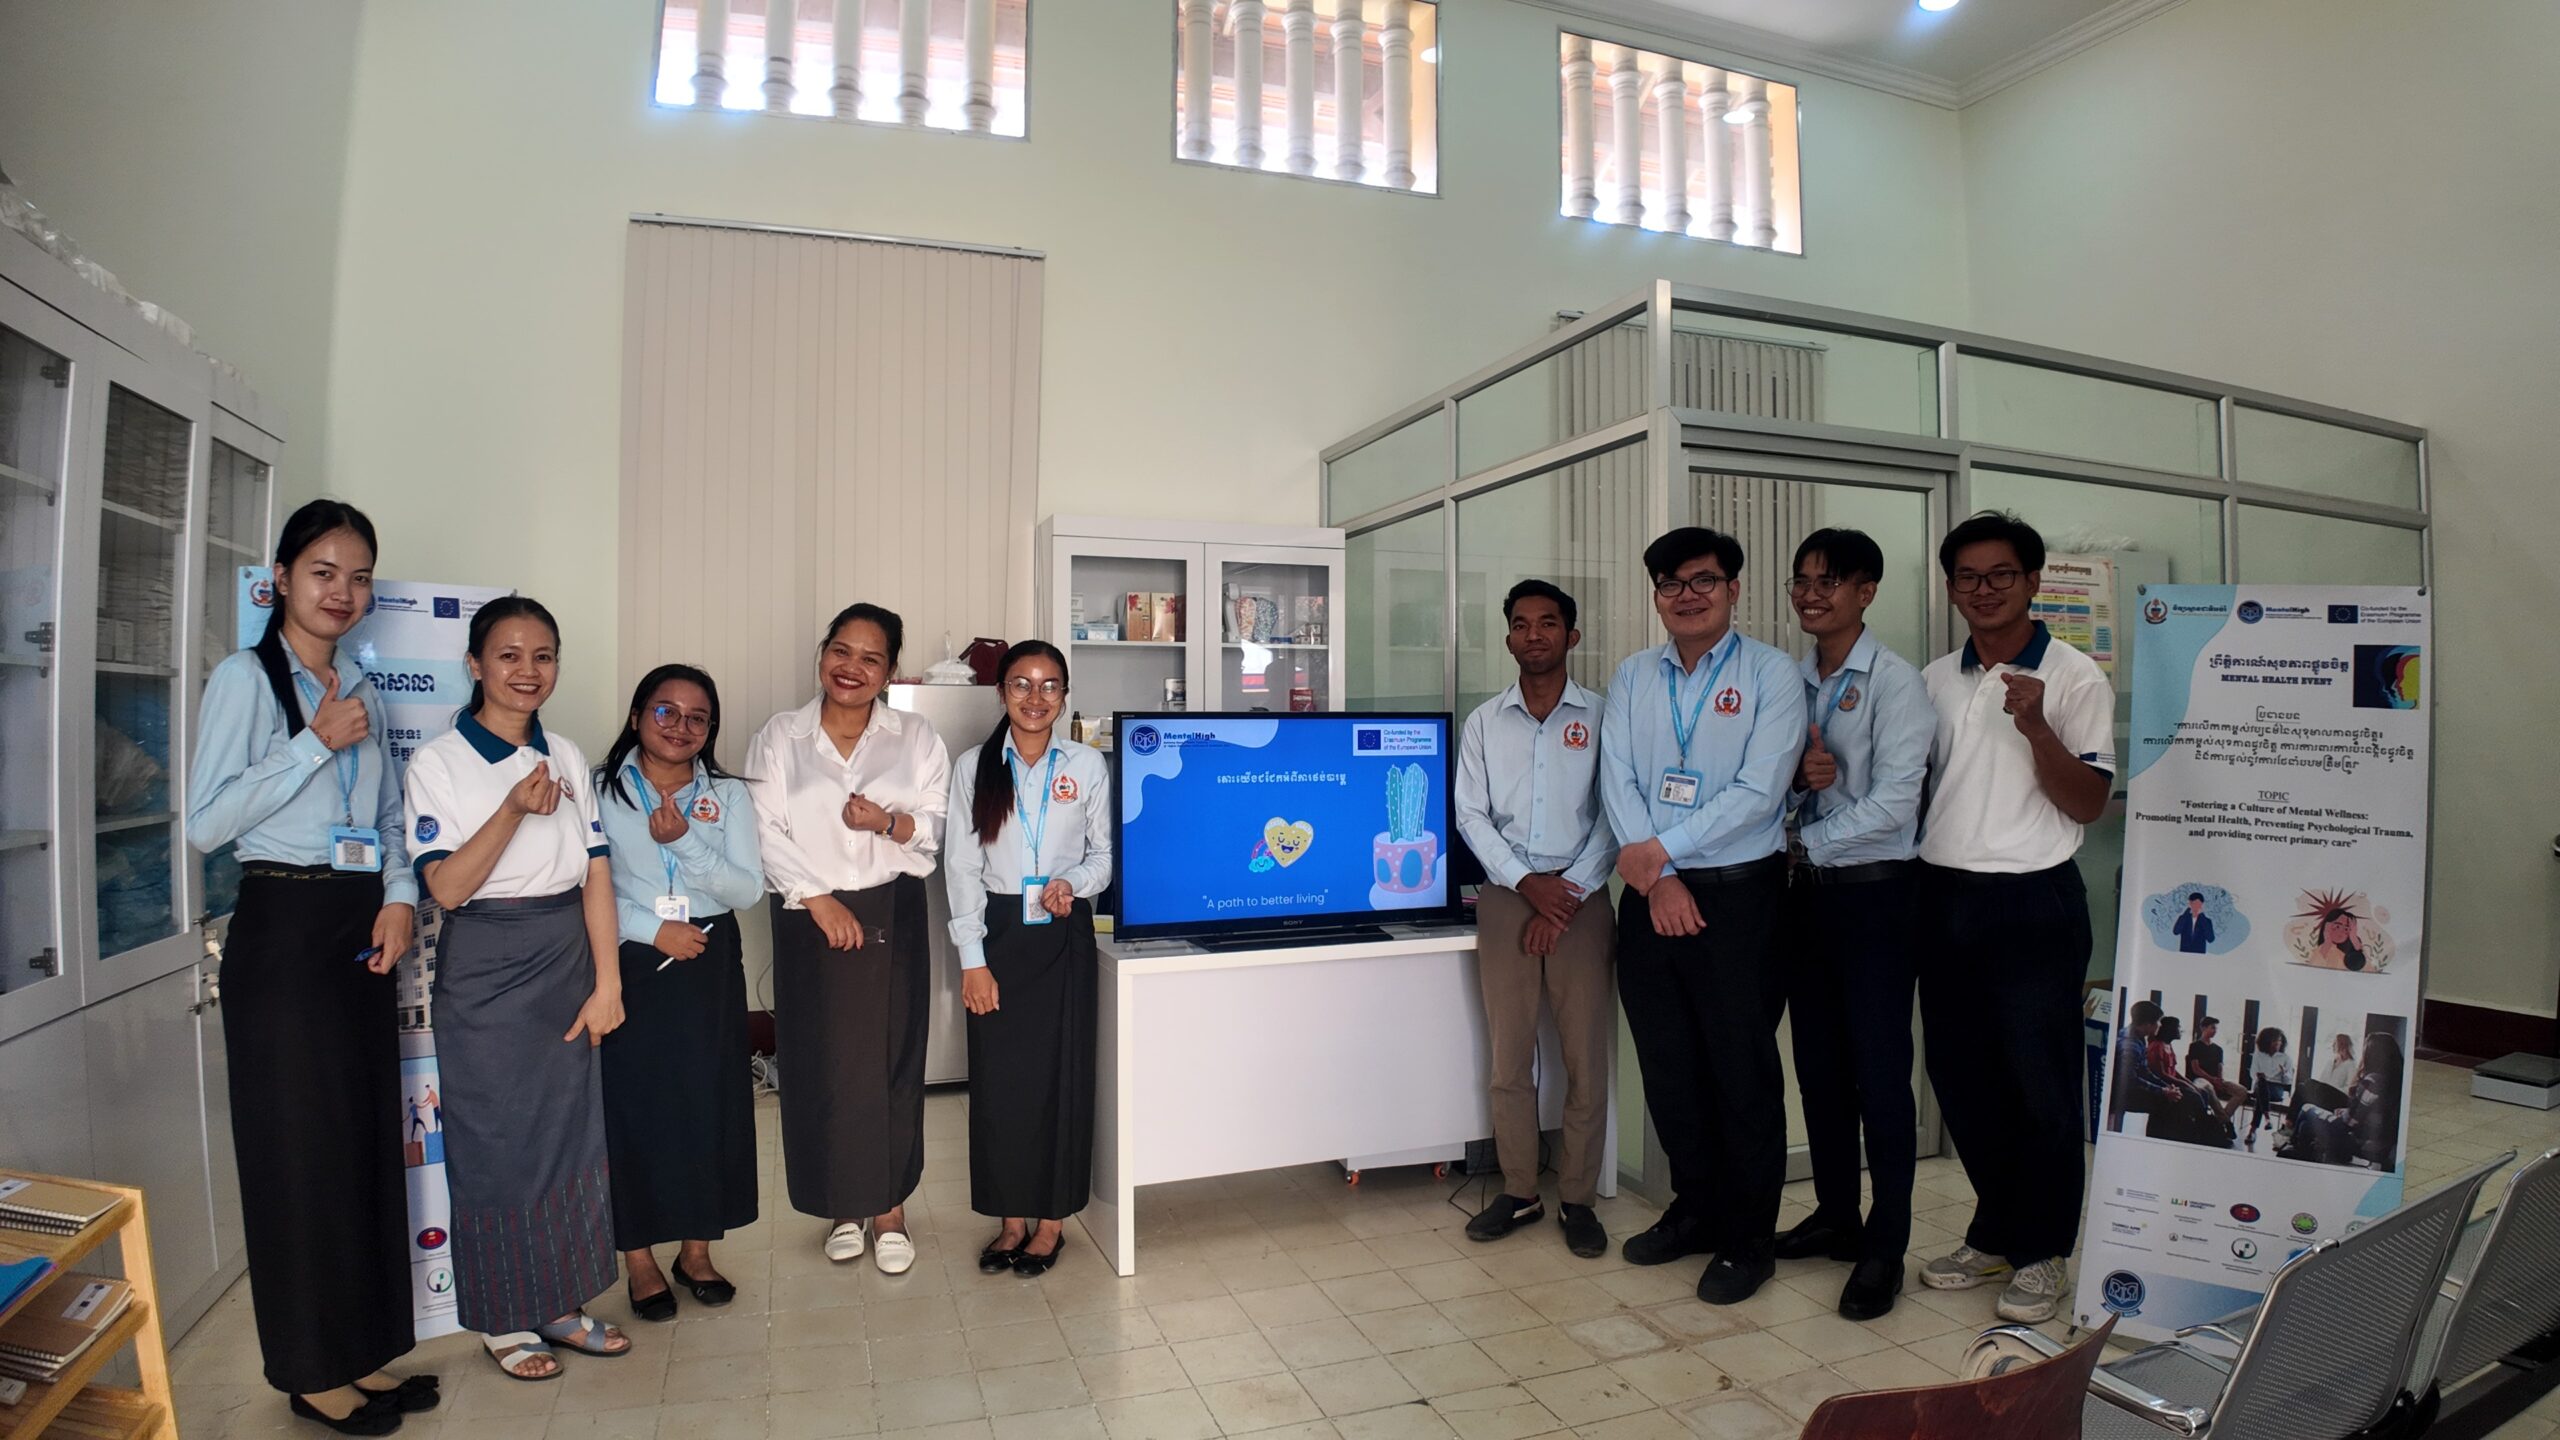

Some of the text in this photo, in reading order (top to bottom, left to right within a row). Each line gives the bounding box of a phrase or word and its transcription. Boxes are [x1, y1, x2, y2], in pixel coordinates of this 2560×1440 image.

[2221, 674, 2333, 686] MENTAL HEALTH EVENT
[1163, 732, 1216, 741] MentalHigh
[2257, 790, 2290, 802] TOPIC
[2238, 802, 2275, 814] Culture
[2276, 806, 2287, 814] of
[2288, 807, 2323, 817] Mental
[2325, 808, 2369, 820] Wellness:
[2135, 812, 2414, 838] Promoting Mental Health, Preventing Psychological Trauma,
[2188, 828, 2205, 837] and
[2207, 829, 2252, 841] providing
[2254, 833, 2288, 843] correct
[2289, 835, 2329, 848] primary
[1217, 897, 1244, 911] path
[1247, 897, 1258, 906] to
[1261, 895, 1294, 906] better
